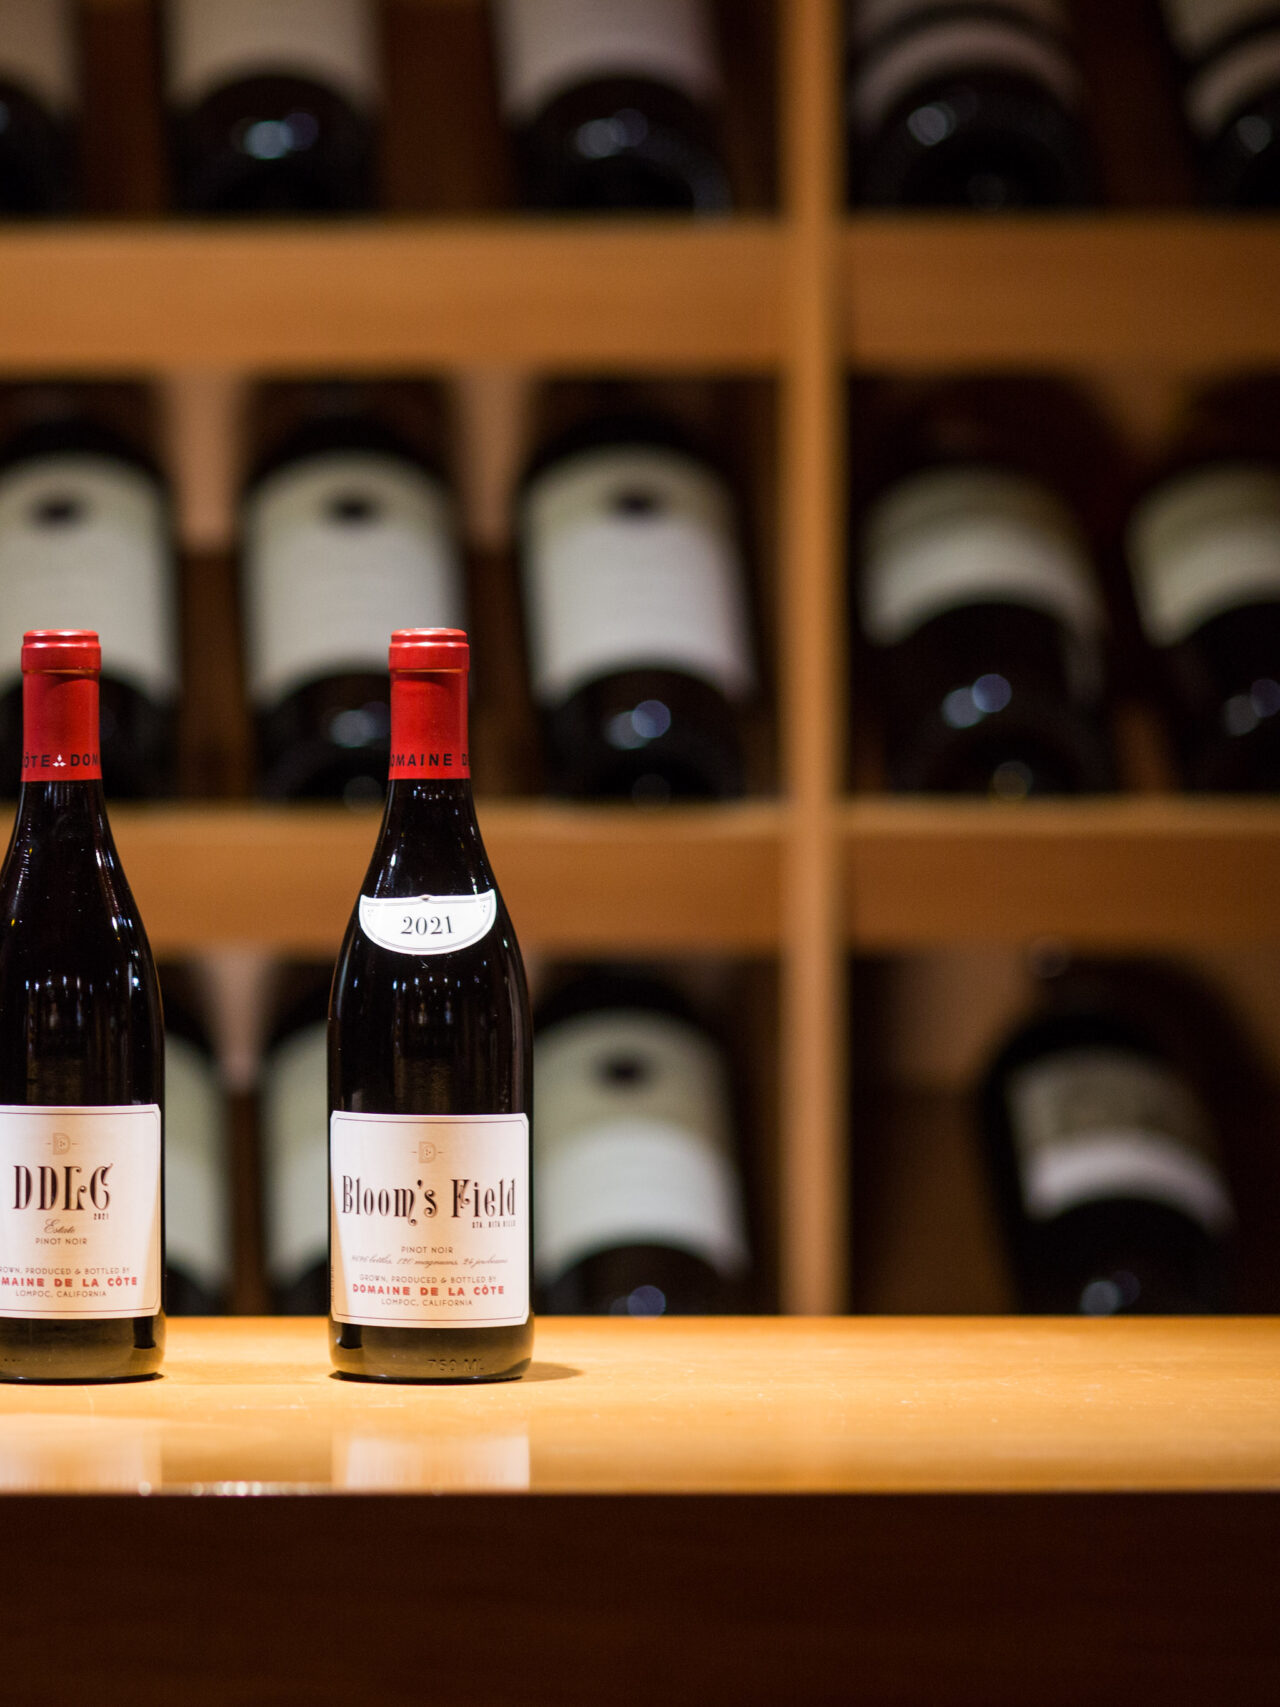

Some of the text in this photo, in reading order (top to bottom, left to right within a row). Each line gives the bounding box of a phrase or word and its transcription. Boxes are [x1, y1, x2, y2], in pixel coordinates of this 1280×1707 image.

[400, 916, 453, 935] 2021
[12, 1163, 113, 1211] DDLC
[342, 1175, 516, 1226] Bloom's Field
[43, 1218, 75, 1234] Estate
[35, 1237, 87, 1245] PINOT NOIR
[401, 1246, 453, 1254] PINOT NOIR
[25, 1266, 71, 1275] PRODUCED
[85, 1267, 119, 1275] BOTTLED
[54, 1278, 73, 1287] DE
[82, 1277, 99, 1287] LA
[107, 1275, 137, 1287] CÔTE
[391, 1275, 437, 1284] PRODUCED
[451, 1275, 486, 1284] BOTTLED
[16, 1290, 106, 1298] LOMPOC, CALIFORNIA
[353, 1283, 504, 1296] DOMAINE DE LA CÔTE
[381, 1299, 472, 1307] LOMPOC, CALIFORNIA
